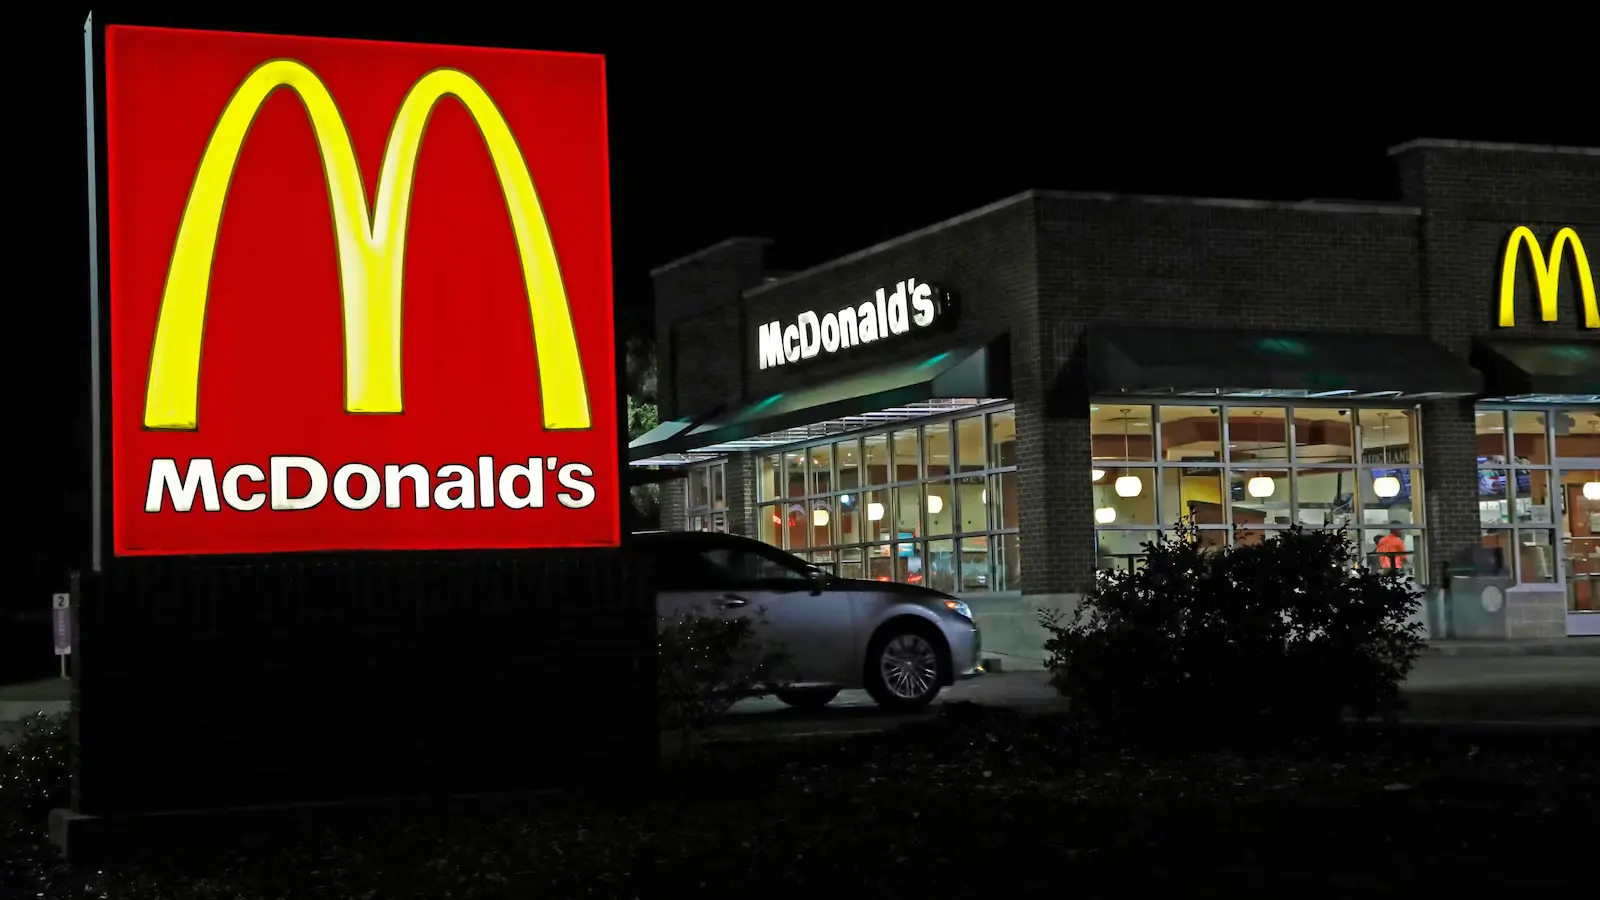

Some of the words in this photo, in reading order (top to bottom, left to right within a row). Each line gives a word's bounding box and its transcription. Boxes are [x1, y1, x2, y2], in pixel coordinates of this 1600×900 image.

[758, 277, 935, 370] McDonald's
[145, 456, 596, 512] McDonald's
[57, 595, 65, 607] 2
